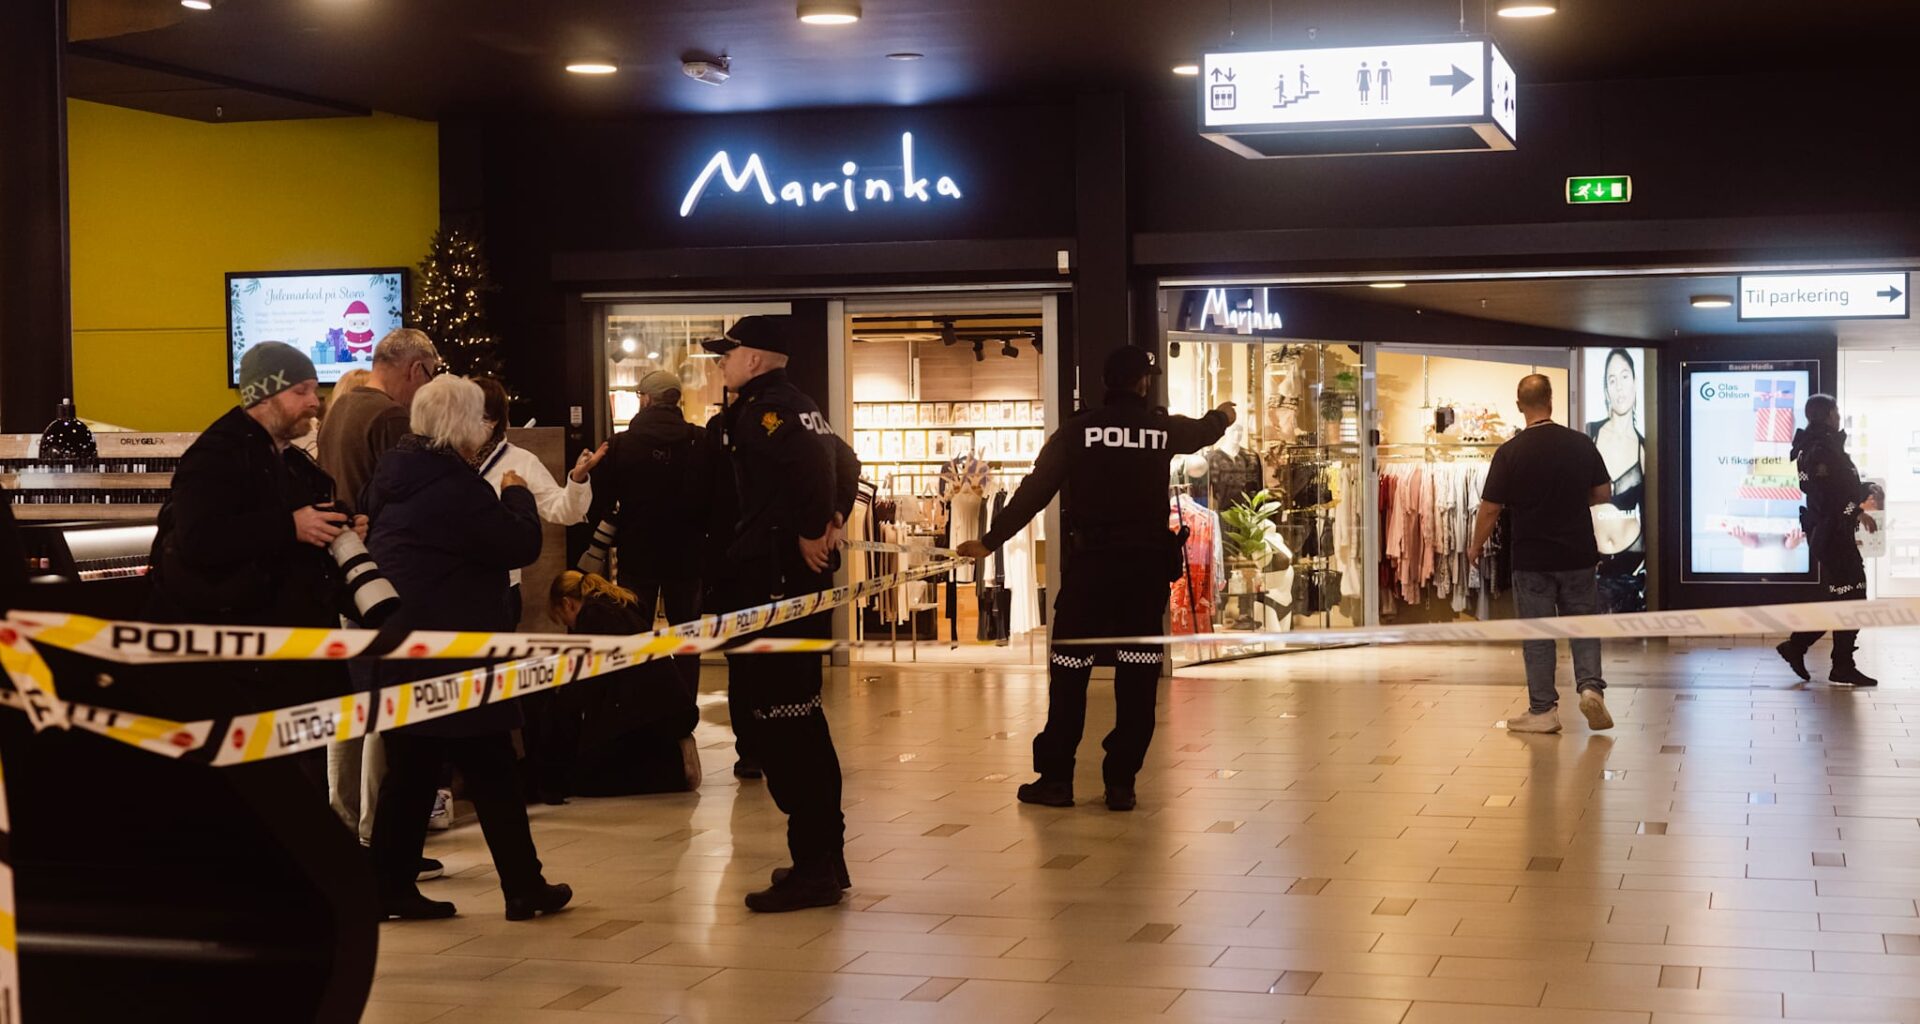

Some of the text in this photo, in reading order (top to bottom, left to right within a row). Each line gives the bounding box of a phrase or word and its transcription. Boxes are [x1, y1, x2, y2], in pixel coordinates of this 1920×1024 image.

[680, 131, 963, 217] Marinka
[265, 287, 324, 306] Julemarked
[1745, 288, 1850, 307] Til parkering
[1200, 287, 1283, 334] Marinka
[1718, 383, 1739, 391] Clas
[1718, 391, 1750, 399] Ohlson
[1084, 426, 1168, 450] POLITI
[1718, 456, 1782, 465] Vi fikser det!
[111, 625, 266, 656] POLITI
[412, 678, 461, 709] POLITI
